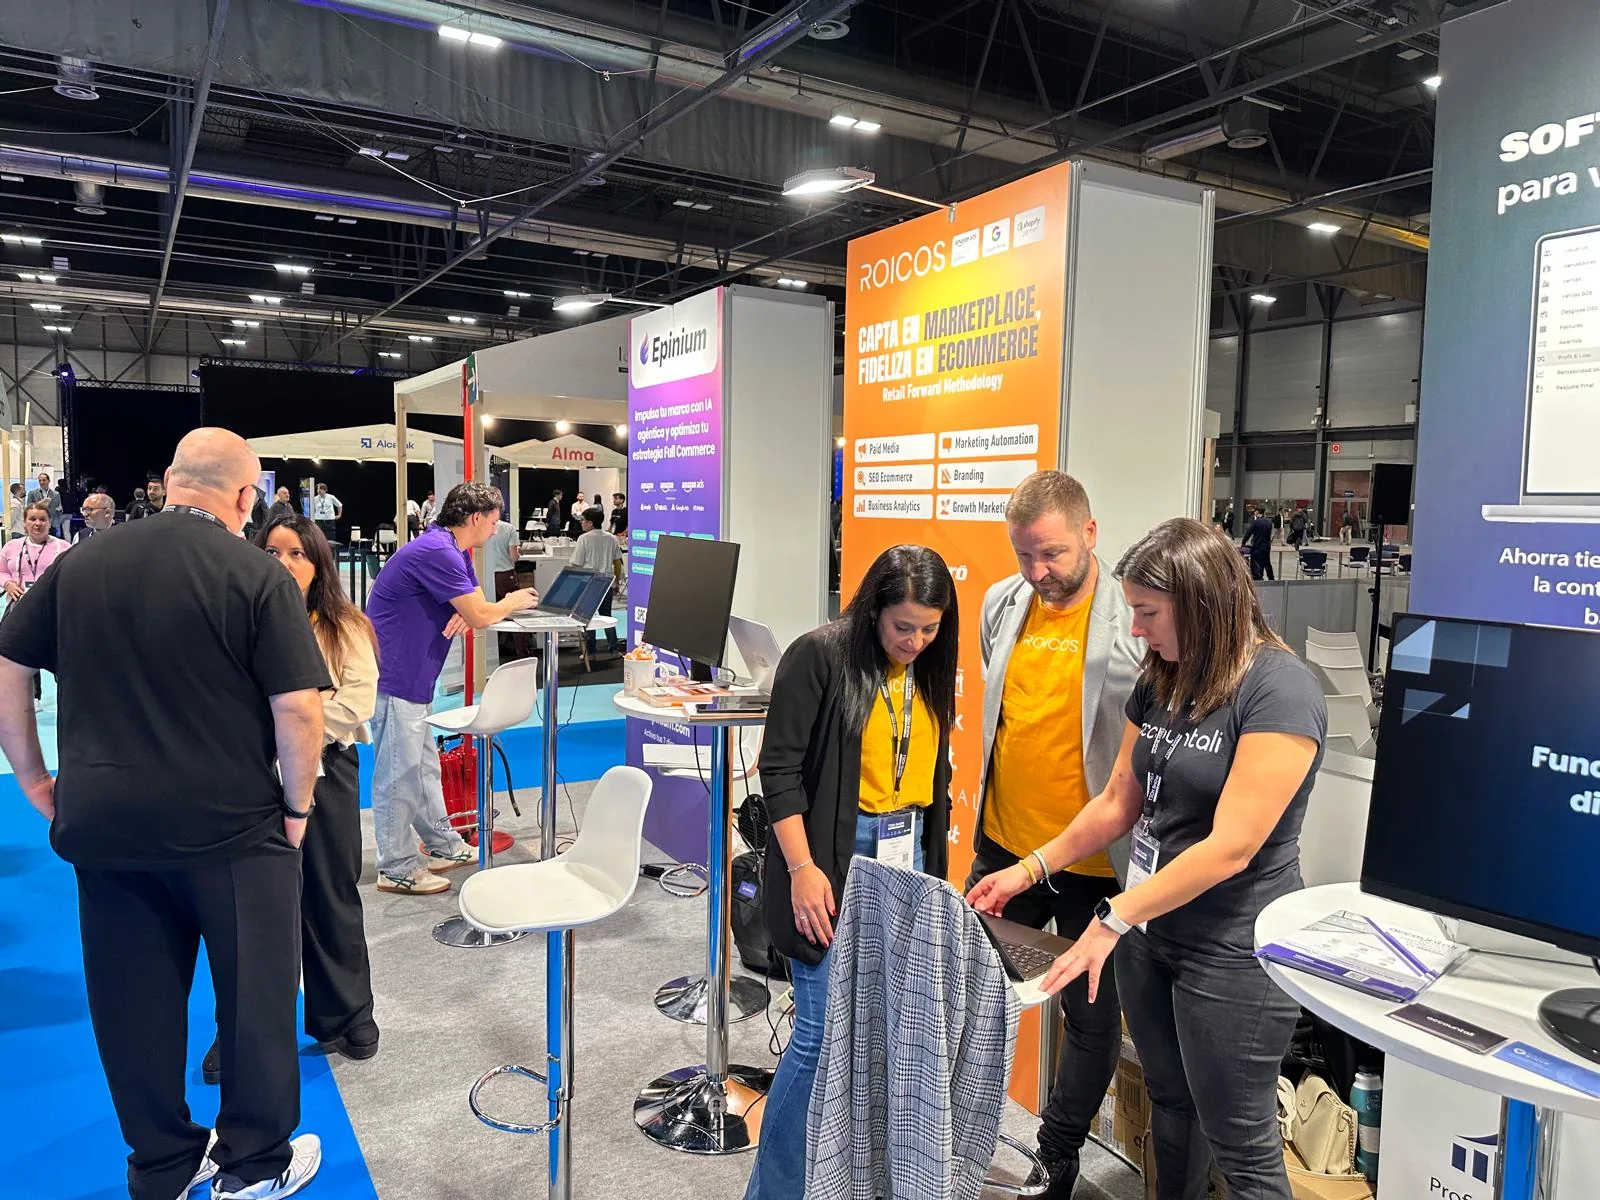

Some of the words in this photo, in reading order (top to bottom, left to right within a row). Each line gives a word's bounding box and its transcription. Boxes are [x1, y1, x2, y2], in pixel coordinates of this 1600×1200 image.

[1498, 112, 1600, 162] SOF
[1498, 172, 1577, 215] para
[860, 240, 946, 292] ROICOS
[858, 319, 898, 353] CAPTA
[902, 314, 920, 346] EN
[924, 285, 1041, 341] MARKETPLACE,
[652, 327, 707, 368] Epinium
[858, 350, 911, 385] FIDELIZA
[916, 347, 933, 376] EN
[938, 324, 1038, 372] ECOMMERCE
[882, 384, 906, 402] Retail
[908, 380, 941, 399] Forward
[944, 373, 1003, 395] Methodology
[634, 408, 659, 424] Impulsa
[660, 406, 667, 417] tu
[667, 403, 689, 416] marca
[691, 401, 704, 413] con
[665, 427, 670, 441] y
[670, 422, 700, 440] optimiza
[701, 421, 709, 433] tu
[955, 435, 989, 450] Marketing
[991, 432, 1033, 446] Automation
[552, 447, 594, 461] Alma
[632, 446, 663, 463] estrategia
[664, 445, 676, 458] Full
[676, 443, 715, 458] Commerce
[869, 443, 881, 455] Paid
[882, 442, 899, 453] Media
[868, 472, 879, 482] SEO
[880, 472, 912, 482] Ecommerce
[954, 469, 984, 483] Branding
[868, 500, 892, 511] Business
[893, 500, 920, 514] Analytics
[953, 501, 976, 513] Growth
[978, 501, 1005, 514] Marketi
[1499, 547, 1569, 567] Ahorra
[1575, 551, 1600, 568] tie
[1533, 575, 1550, 592] la
[1584, 607, 1600, 625] b
[1023, 634, 1079, 652] ROICOS
[1570, 791, 1600, 815] di
